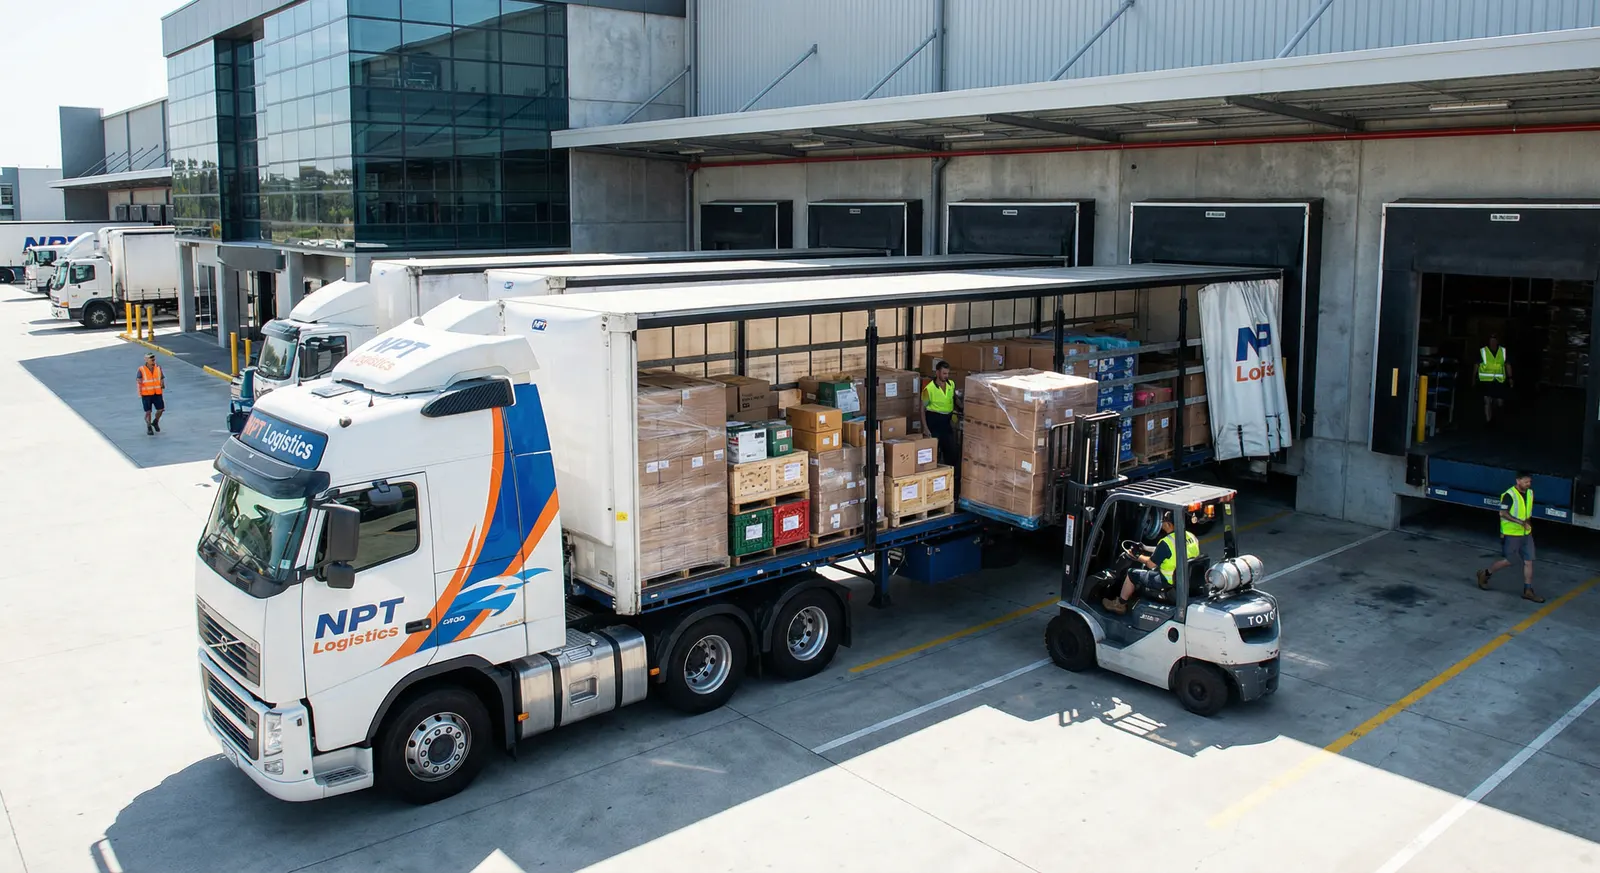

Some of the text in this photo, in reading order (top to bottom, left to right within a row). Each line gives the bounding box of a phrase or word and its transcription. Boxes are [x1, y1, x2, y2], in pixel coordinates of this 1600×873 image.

[366, 337, 431, 358] NPT
[350, 353, 395, 371] Logistics
[241, 414, 314, 460] NPT Logistics
[314, 596, 405, 640] NPT
[1247, 607, 1276, 626] TOYO
[312, 626, 399, 654] Logistics
